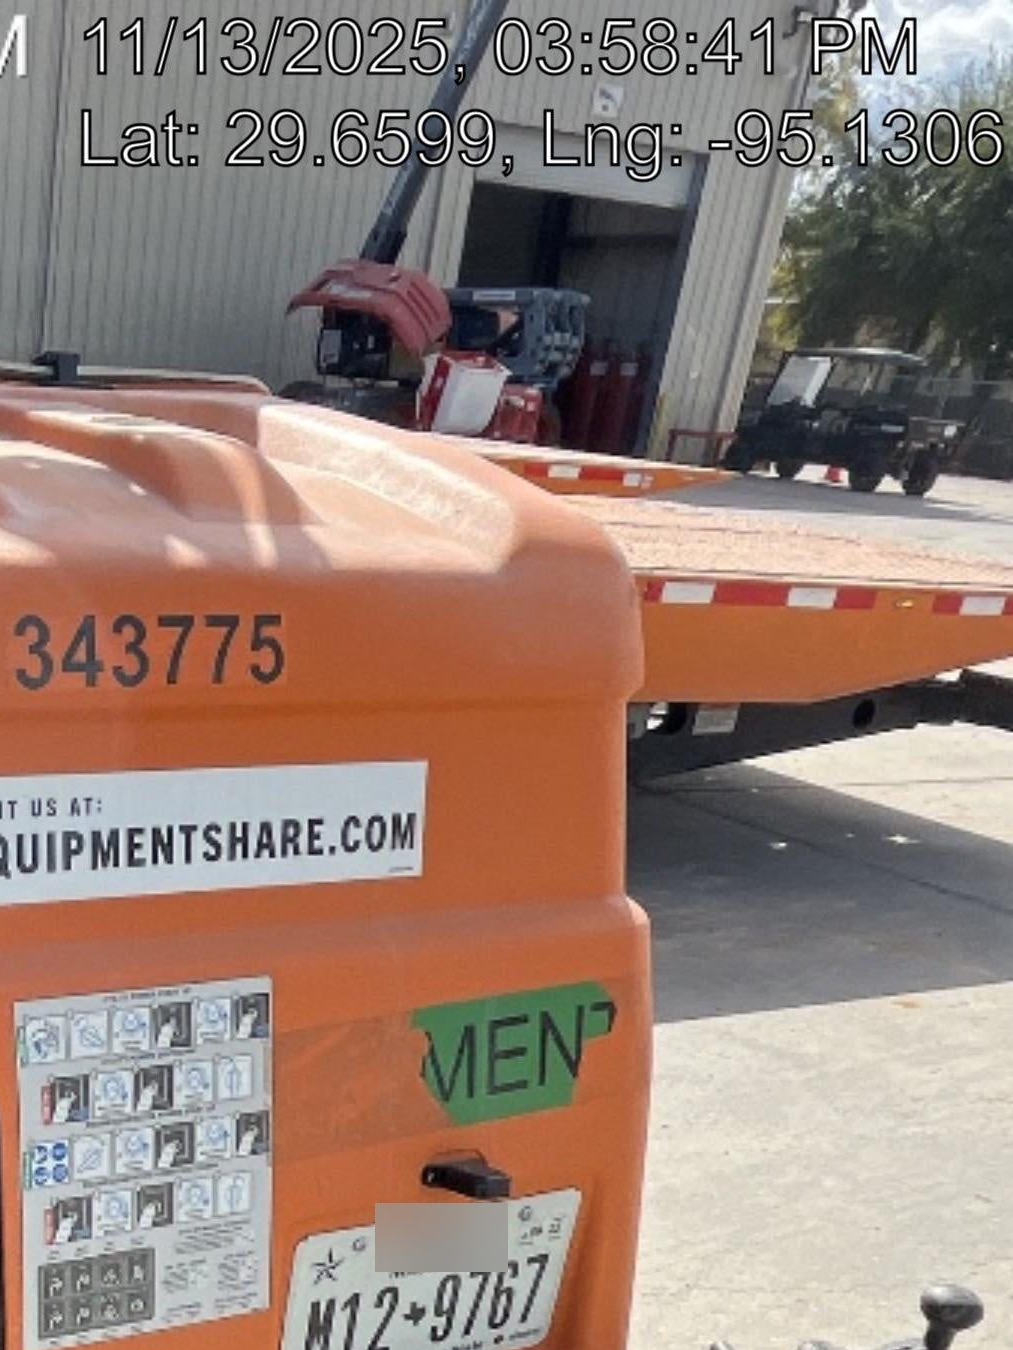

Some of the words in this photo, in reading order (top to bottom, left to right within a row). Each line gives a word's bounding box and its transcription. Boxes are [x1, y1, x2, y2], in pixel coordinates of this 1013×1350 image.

[13, 614, 285, 690] 343775
[31, 797, 57, 817] US
[70, 797, 103, 818] AT:
